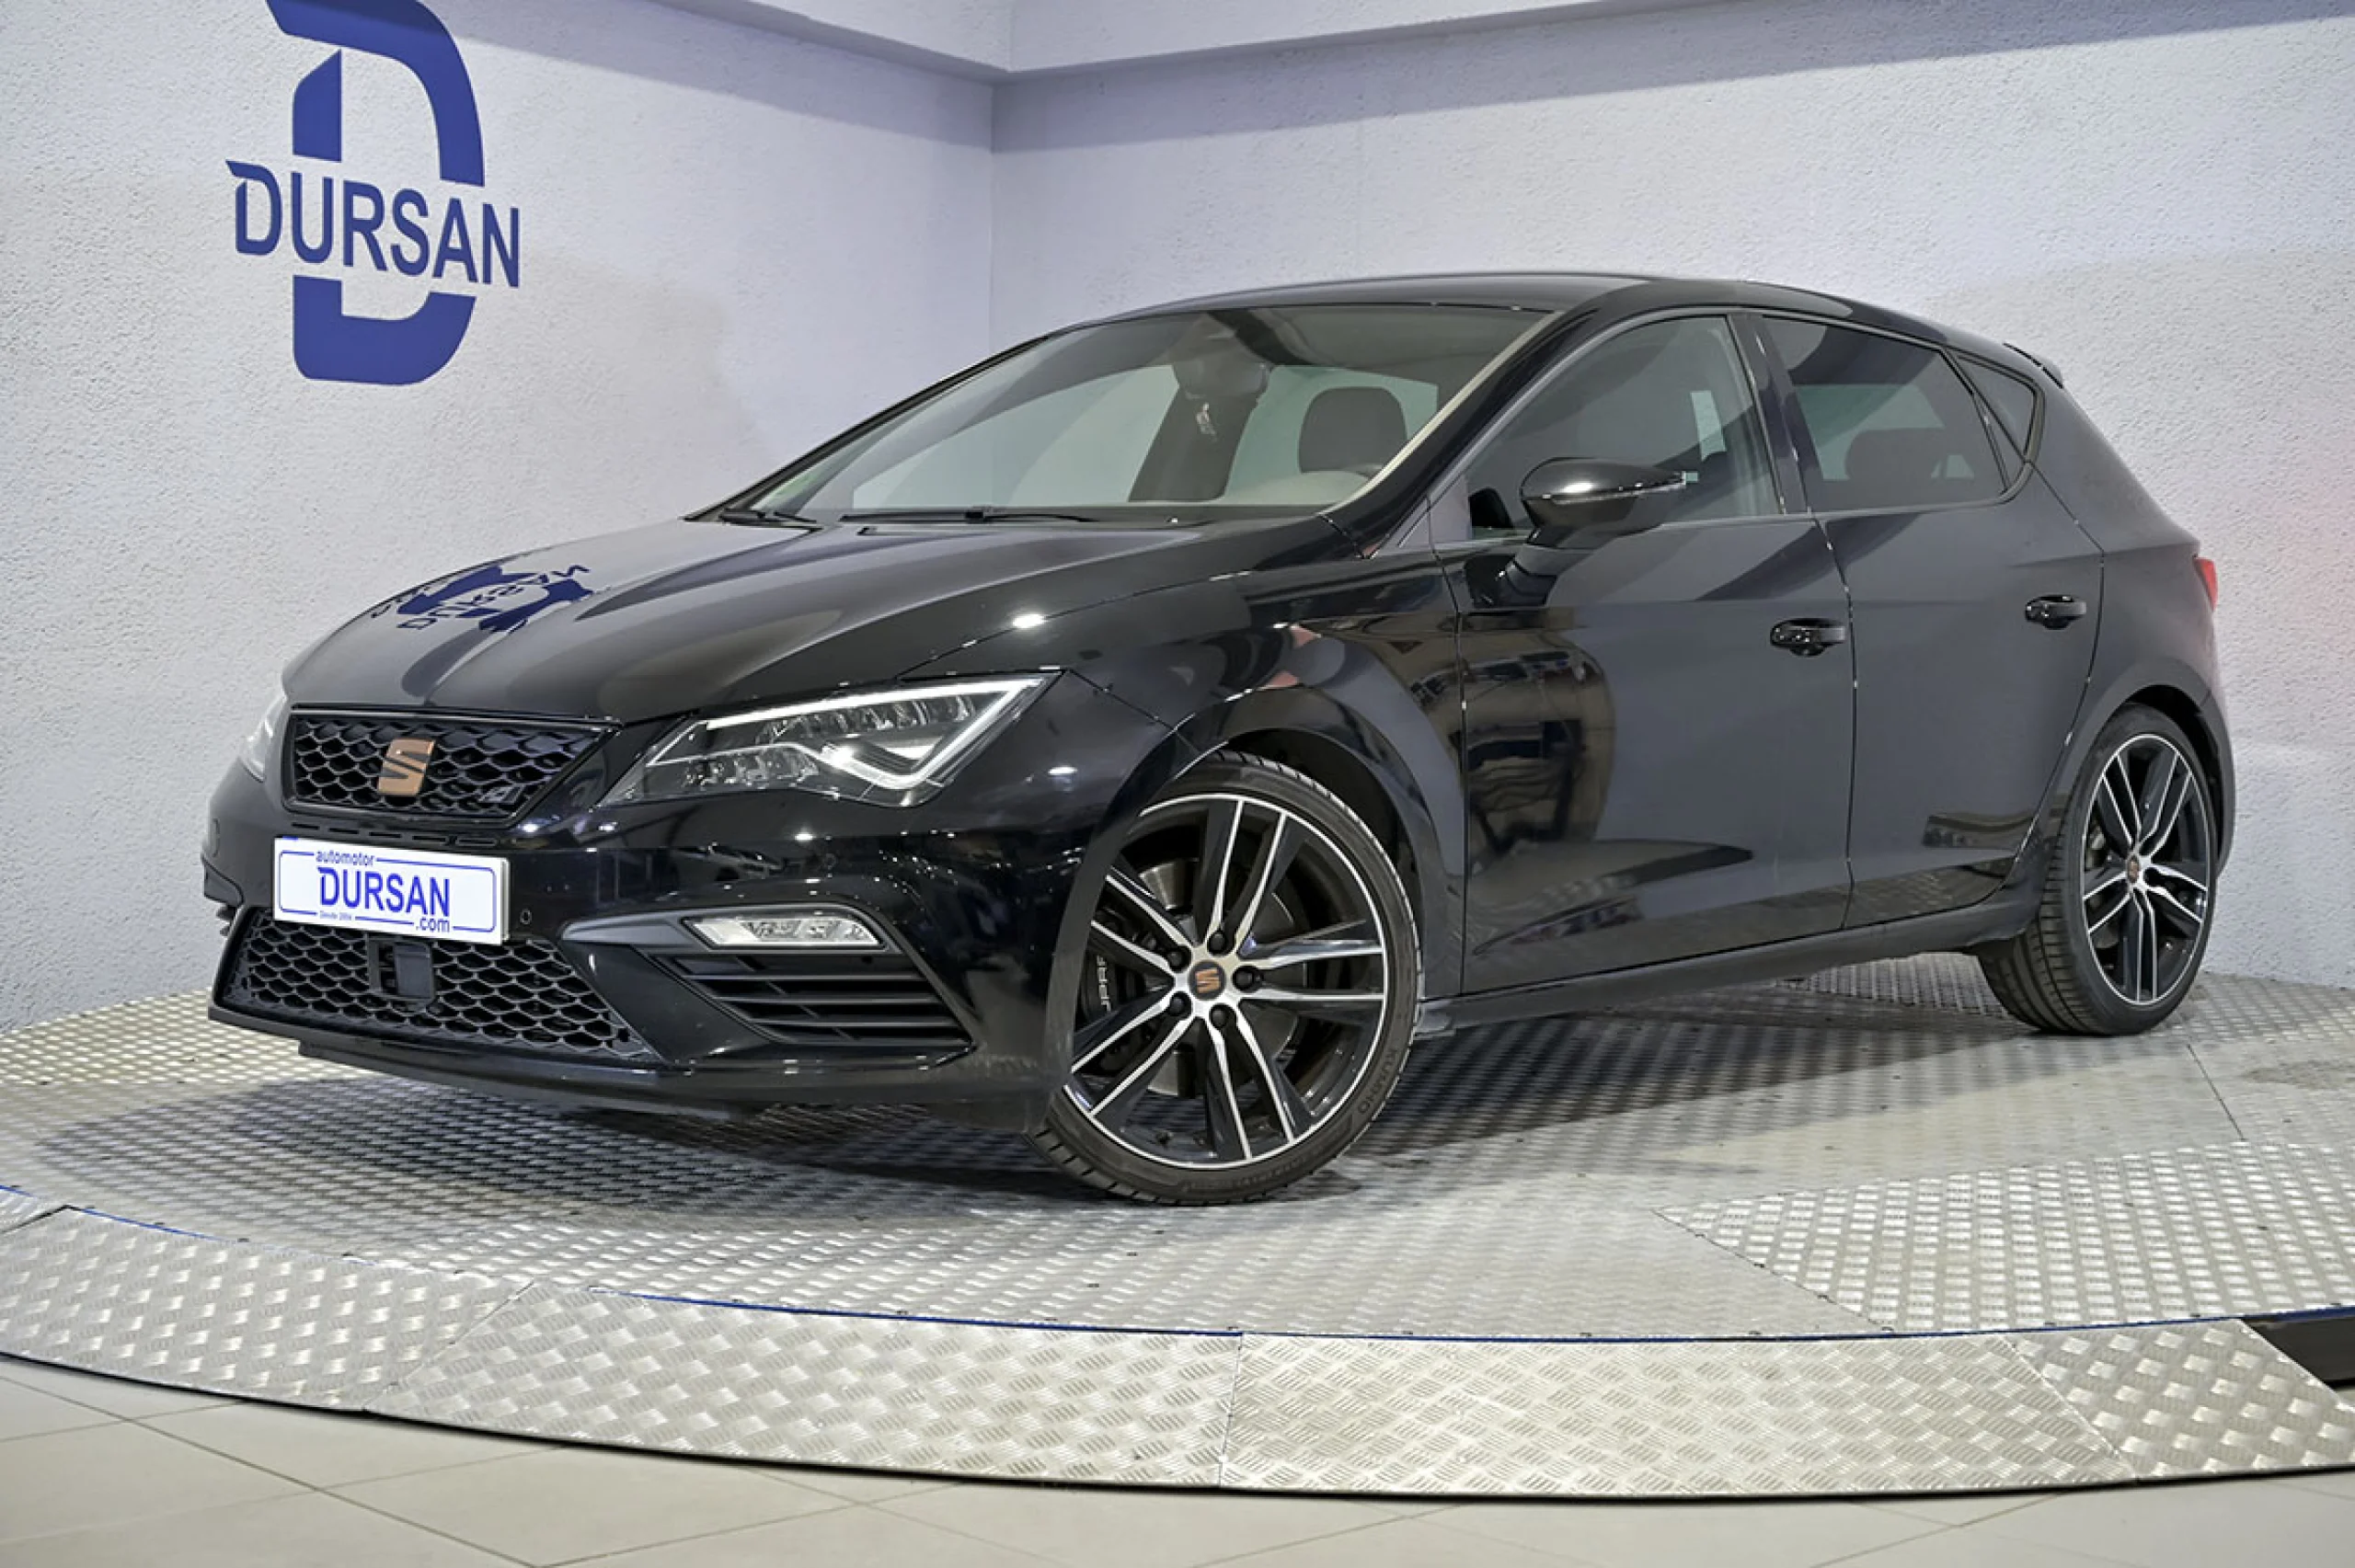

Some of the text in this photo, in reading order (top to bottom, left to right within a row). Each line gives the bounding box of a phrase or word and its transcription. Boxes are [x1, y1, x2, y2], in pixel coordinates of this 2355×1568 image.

[225, 160, 520, 289] DURSAN
[316, 850, 374, 867] automotor
[317, 867, 450, 917] DURSAN
[416, 917, 450, 933] .com
